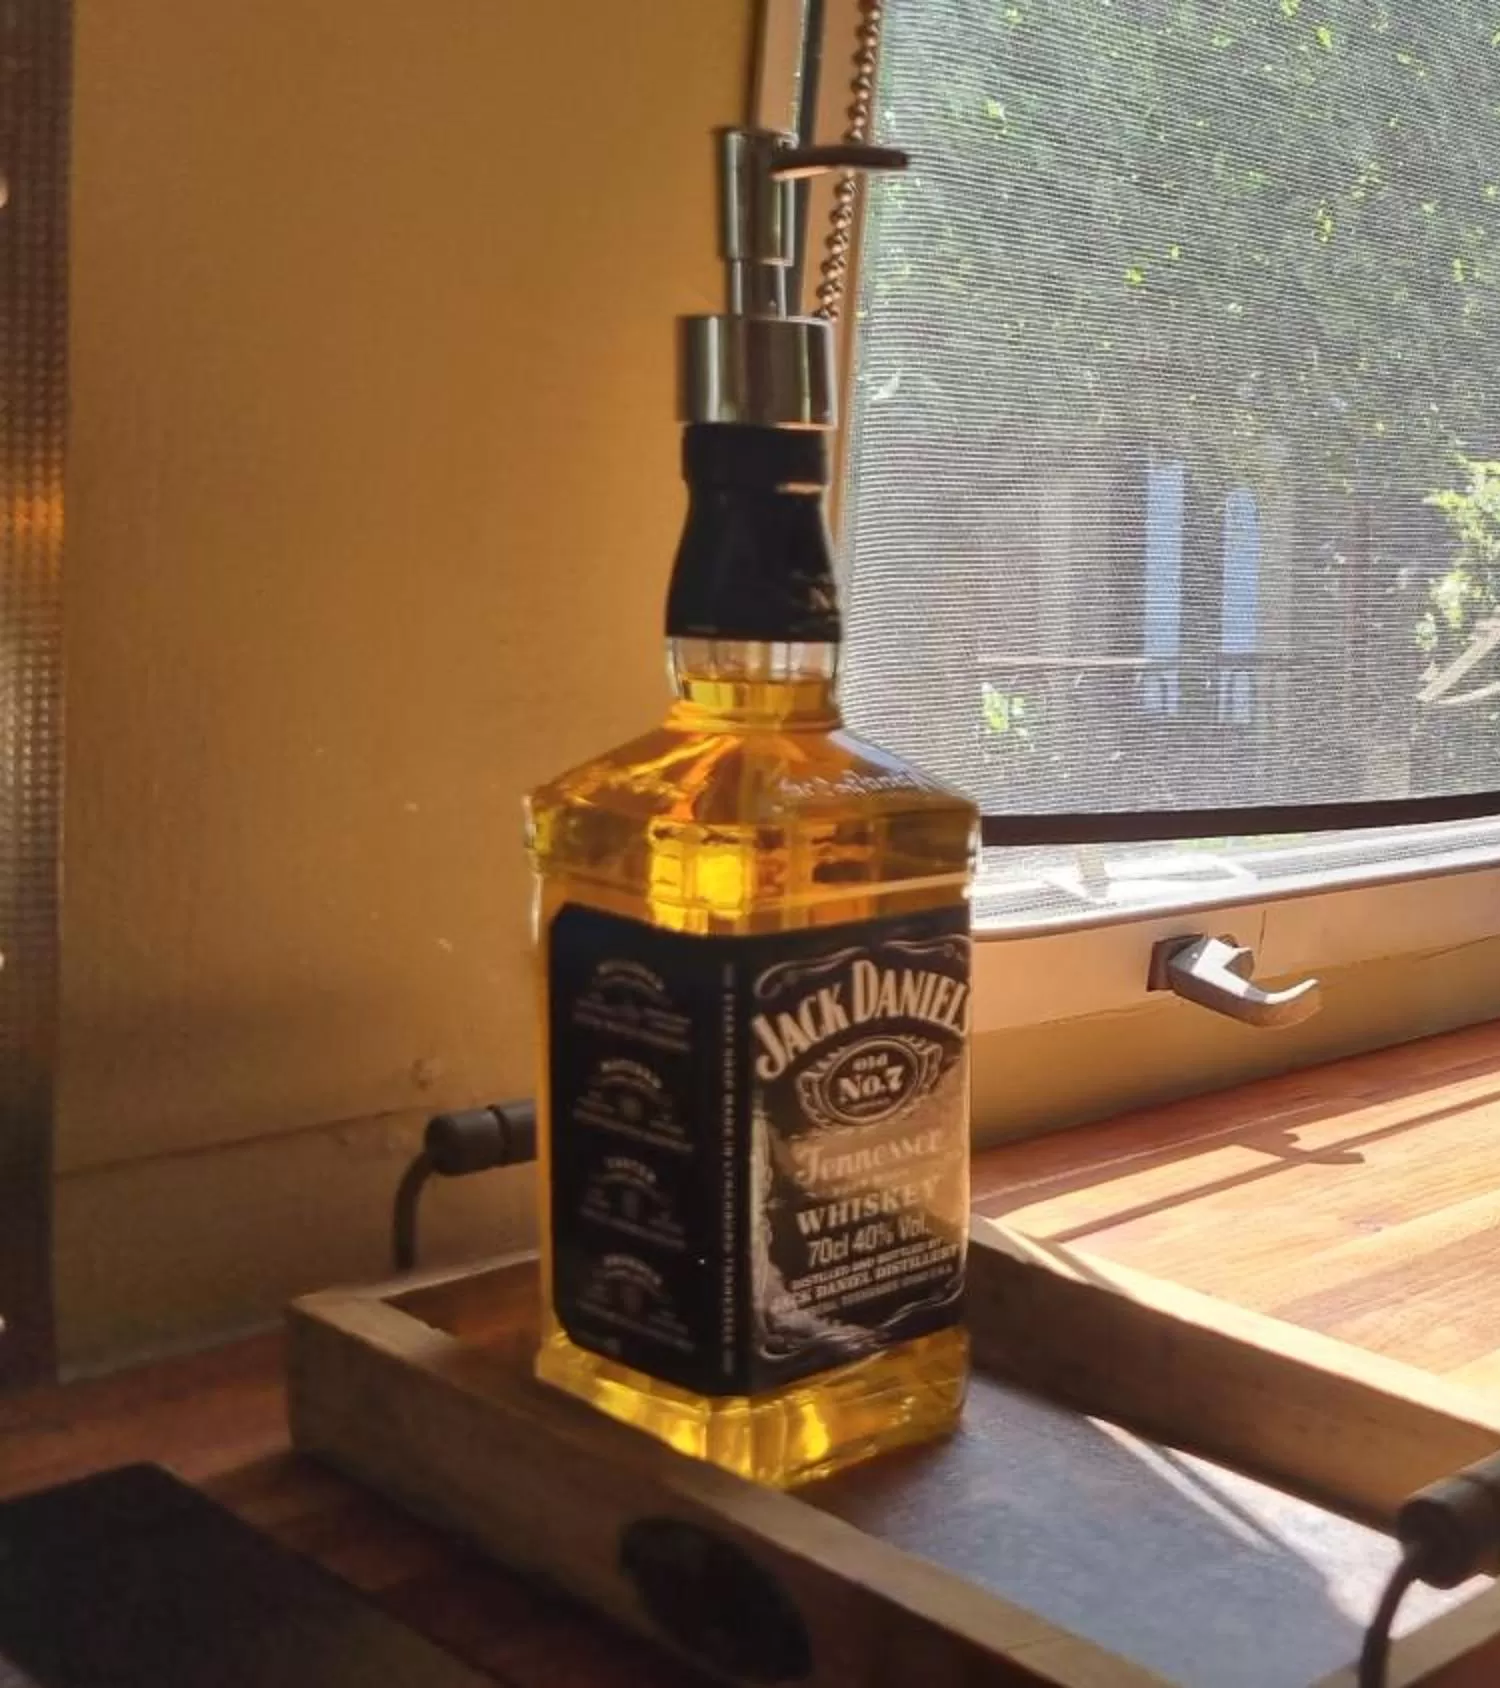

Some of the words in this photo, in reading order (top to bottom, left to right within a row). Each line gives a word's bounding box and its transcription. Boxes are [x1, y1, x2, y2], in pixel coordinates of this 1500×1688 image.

[752, 983, 849, 1080] JACK
[852, 960, 971, 1037] DANIEL
[796, 1175, 942, 1235] WHISKEY
[807, 1232, 850, 1269] 70cl
[852, 1222, 895, 1253] 40%
